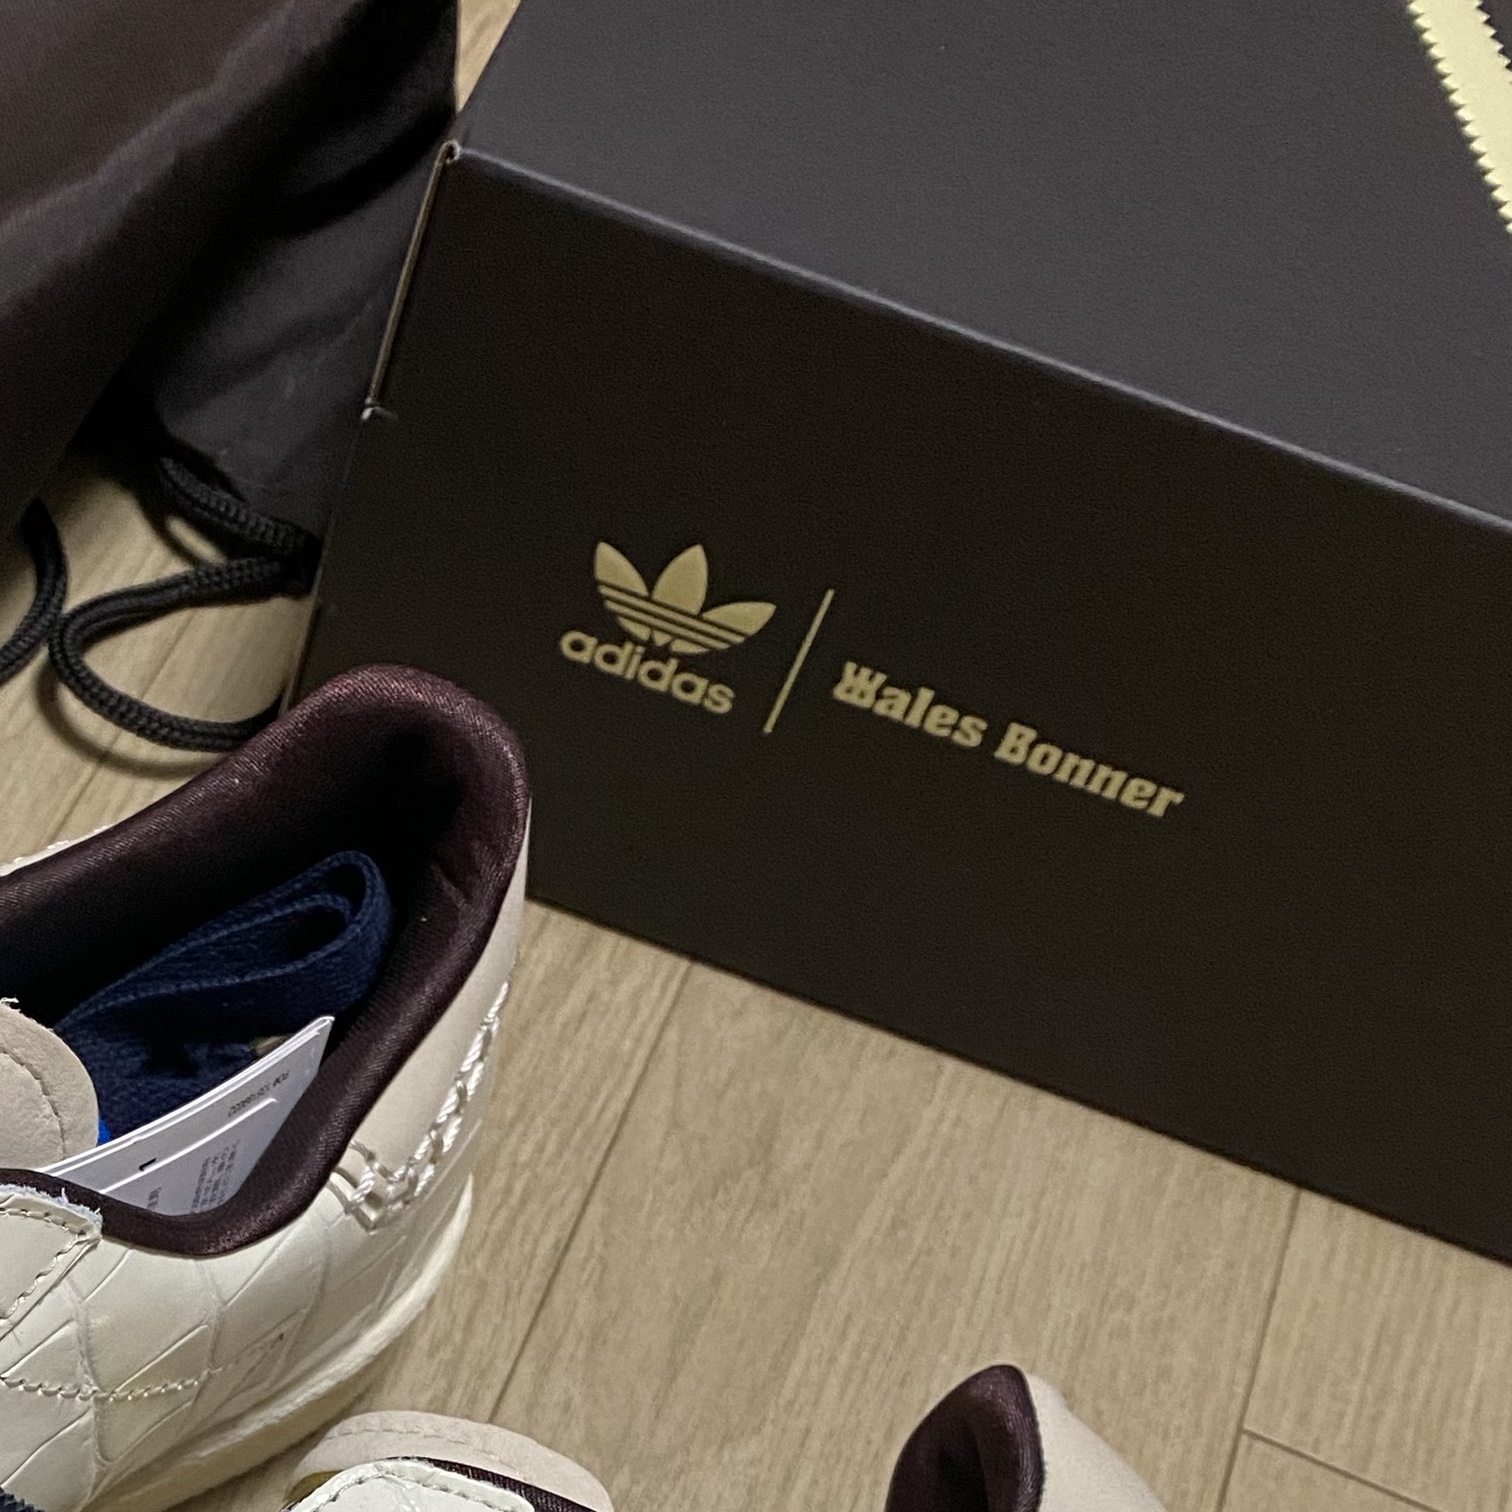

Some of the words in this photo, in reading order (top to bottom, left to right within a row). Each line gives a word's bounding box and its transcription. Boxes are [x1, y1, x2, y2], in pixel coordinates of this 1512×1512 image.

[559, 629, 735, 714] adidas
[832, 661, 988, 748] Wales
[993, 721, 1185, 818] Bonner
